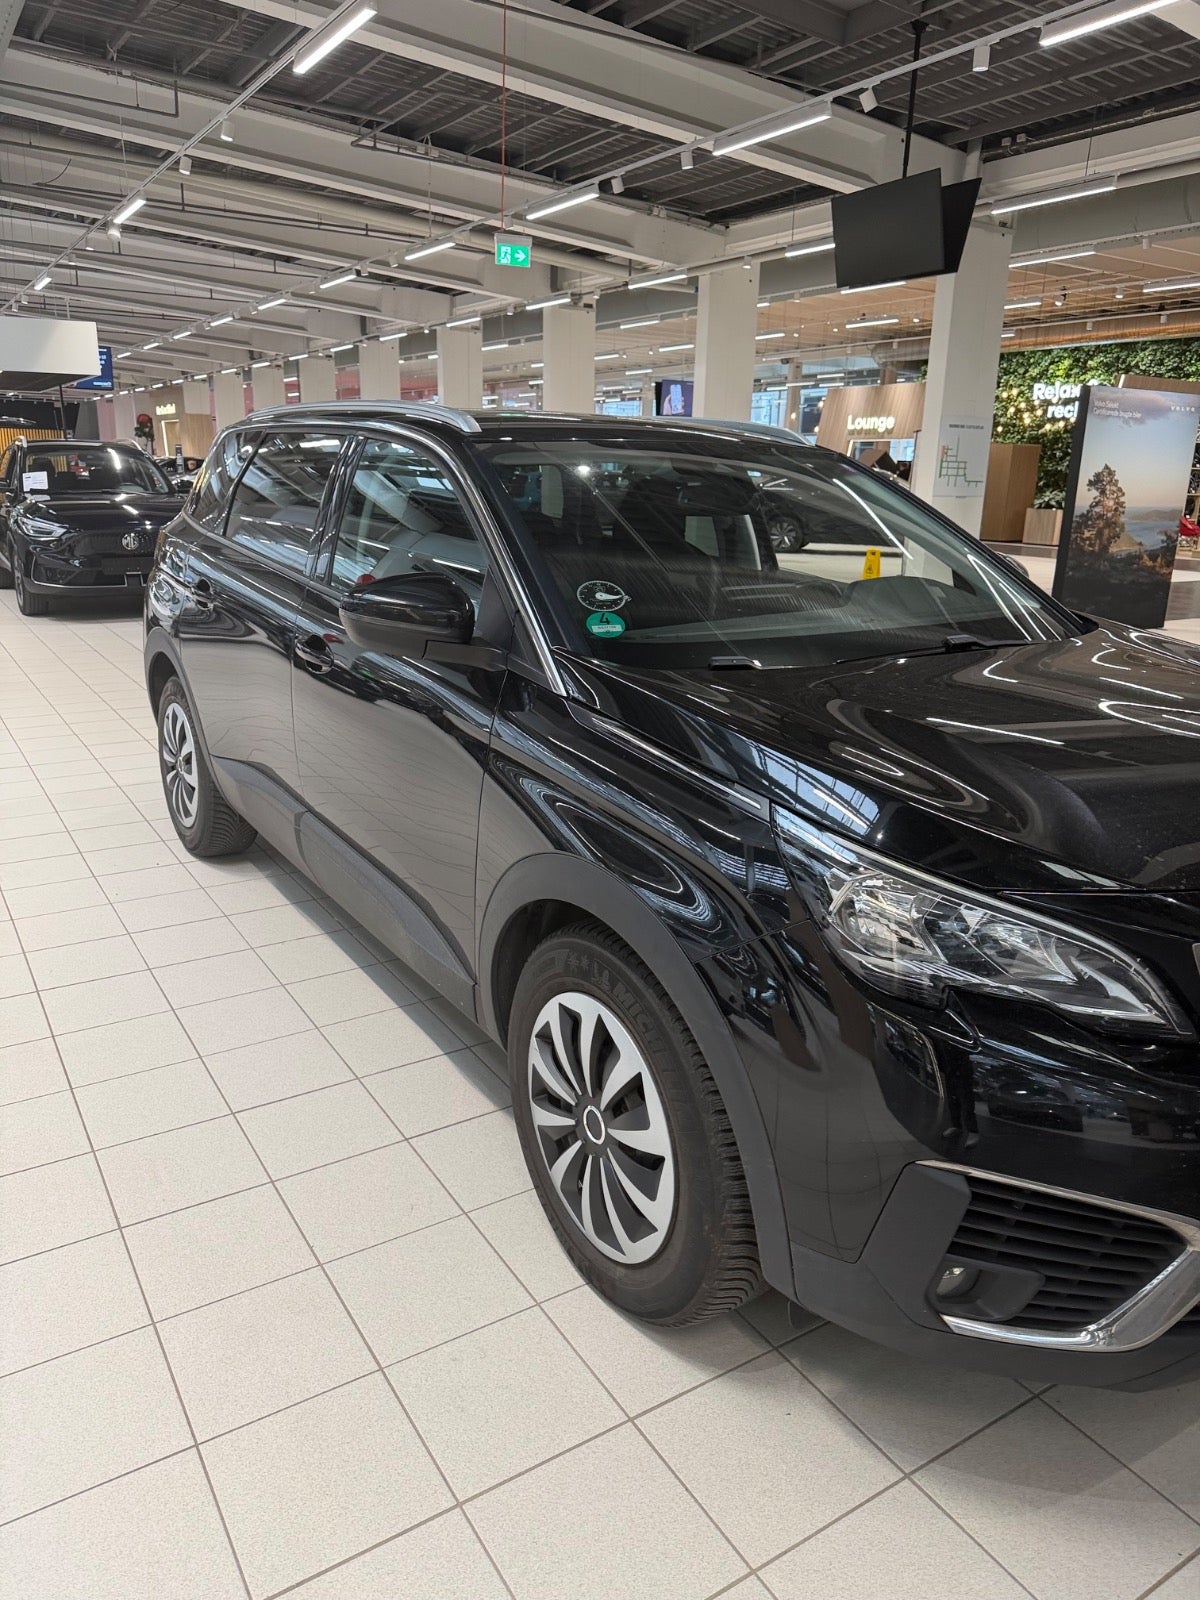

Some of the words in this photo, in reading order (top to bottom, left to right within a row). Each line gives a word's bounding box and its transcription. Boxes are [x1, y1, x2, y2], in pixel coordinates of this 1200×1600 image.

[1032, 381, 1082, 400] Relax
[847, 414, 895, 432] Lounge
[122, 533, 139, 550] MG
[599, 612, 610, 625] 4
